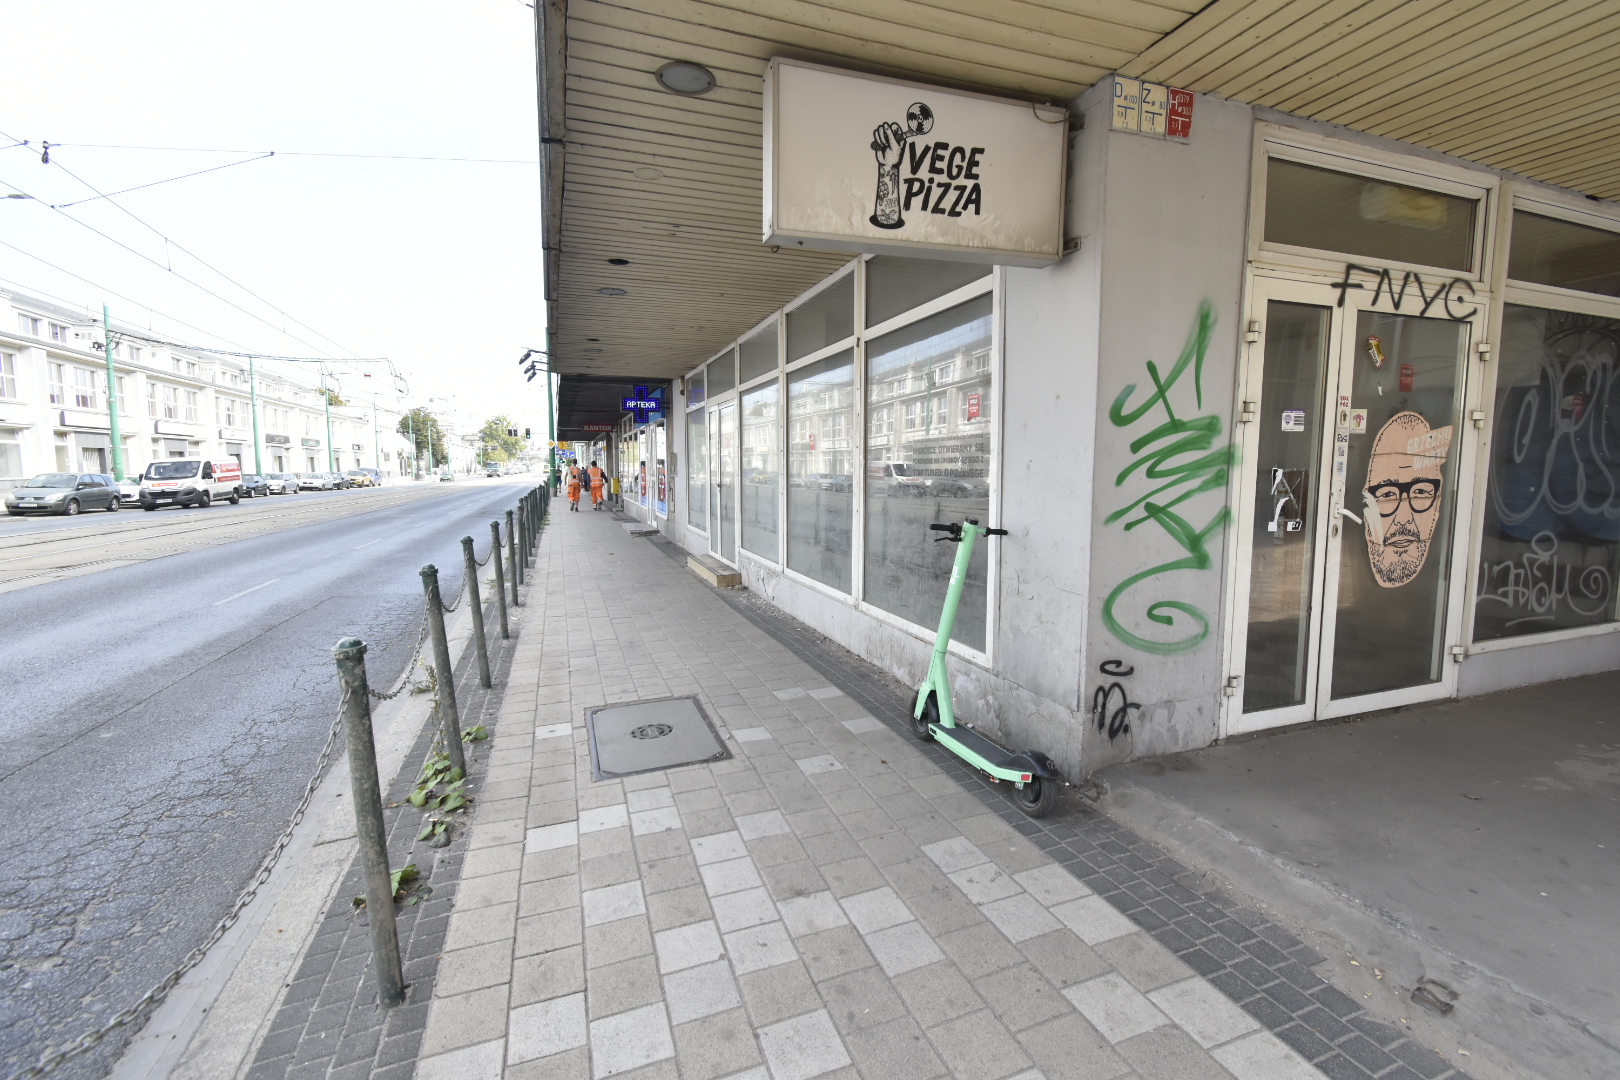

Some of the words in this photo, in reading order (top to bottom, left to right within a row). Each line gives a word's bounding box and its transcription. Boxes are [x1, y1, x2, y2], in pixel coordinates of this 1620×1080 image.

[1115, 82, 1123, 98] D
[1143, 88, 1151, 104] Z
[1169, 94, 1178, 110] H
[909, 141, 985, 180] VEGE
[938, 444, 972, 454] OTWIERAMY
[975, 443, 984, 454] SIĘ
[1407, 426, 1453, 455] GRZECHU
